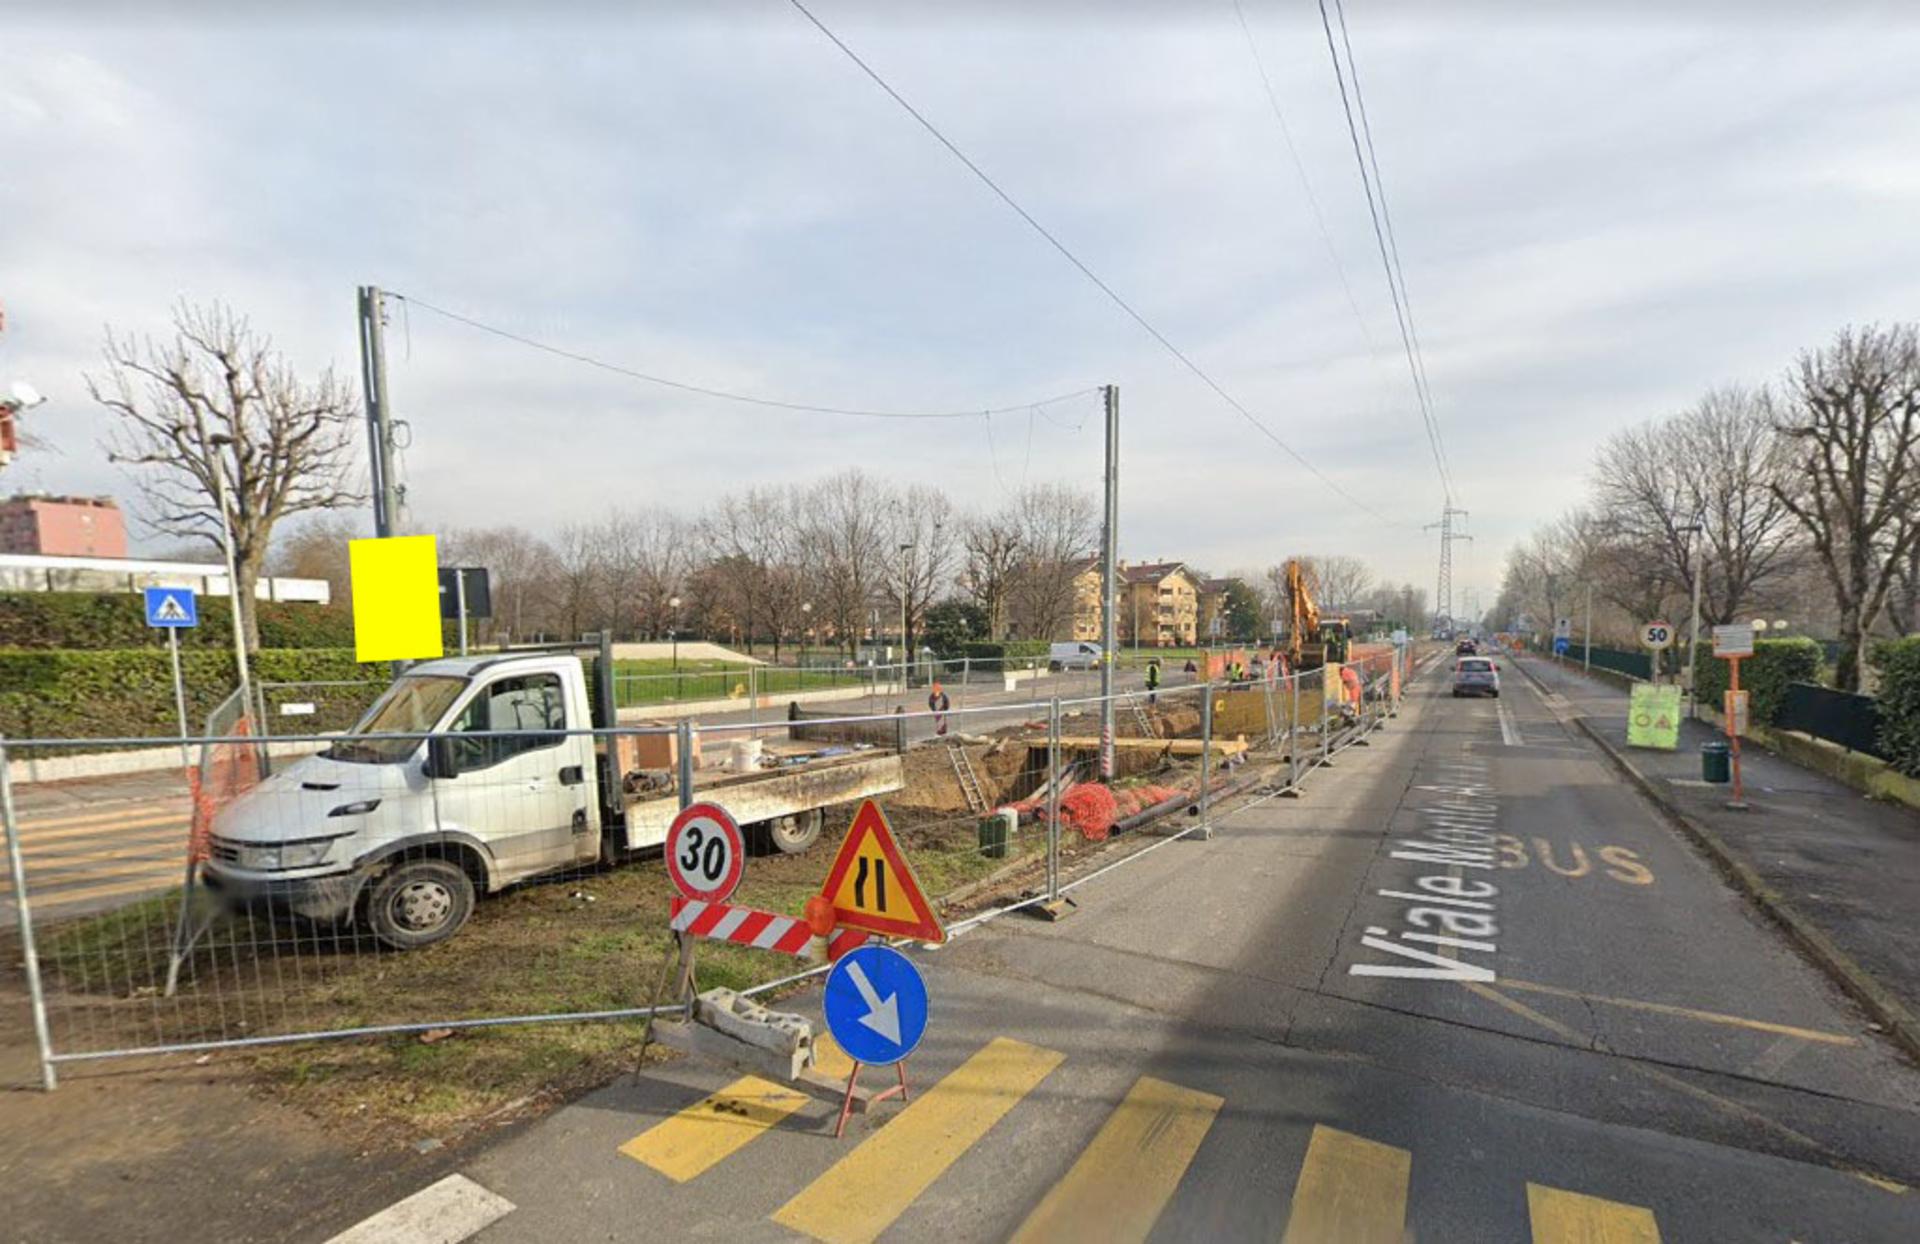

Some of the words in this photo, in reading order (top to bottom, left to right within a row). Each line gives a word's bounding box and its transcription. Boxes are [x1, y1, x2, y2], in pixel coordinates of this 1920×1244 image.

[1647, 627, 1668, 643] 50
[680, 826, 726, 881] 30
[1496, 832, 1655, 886] BUS
